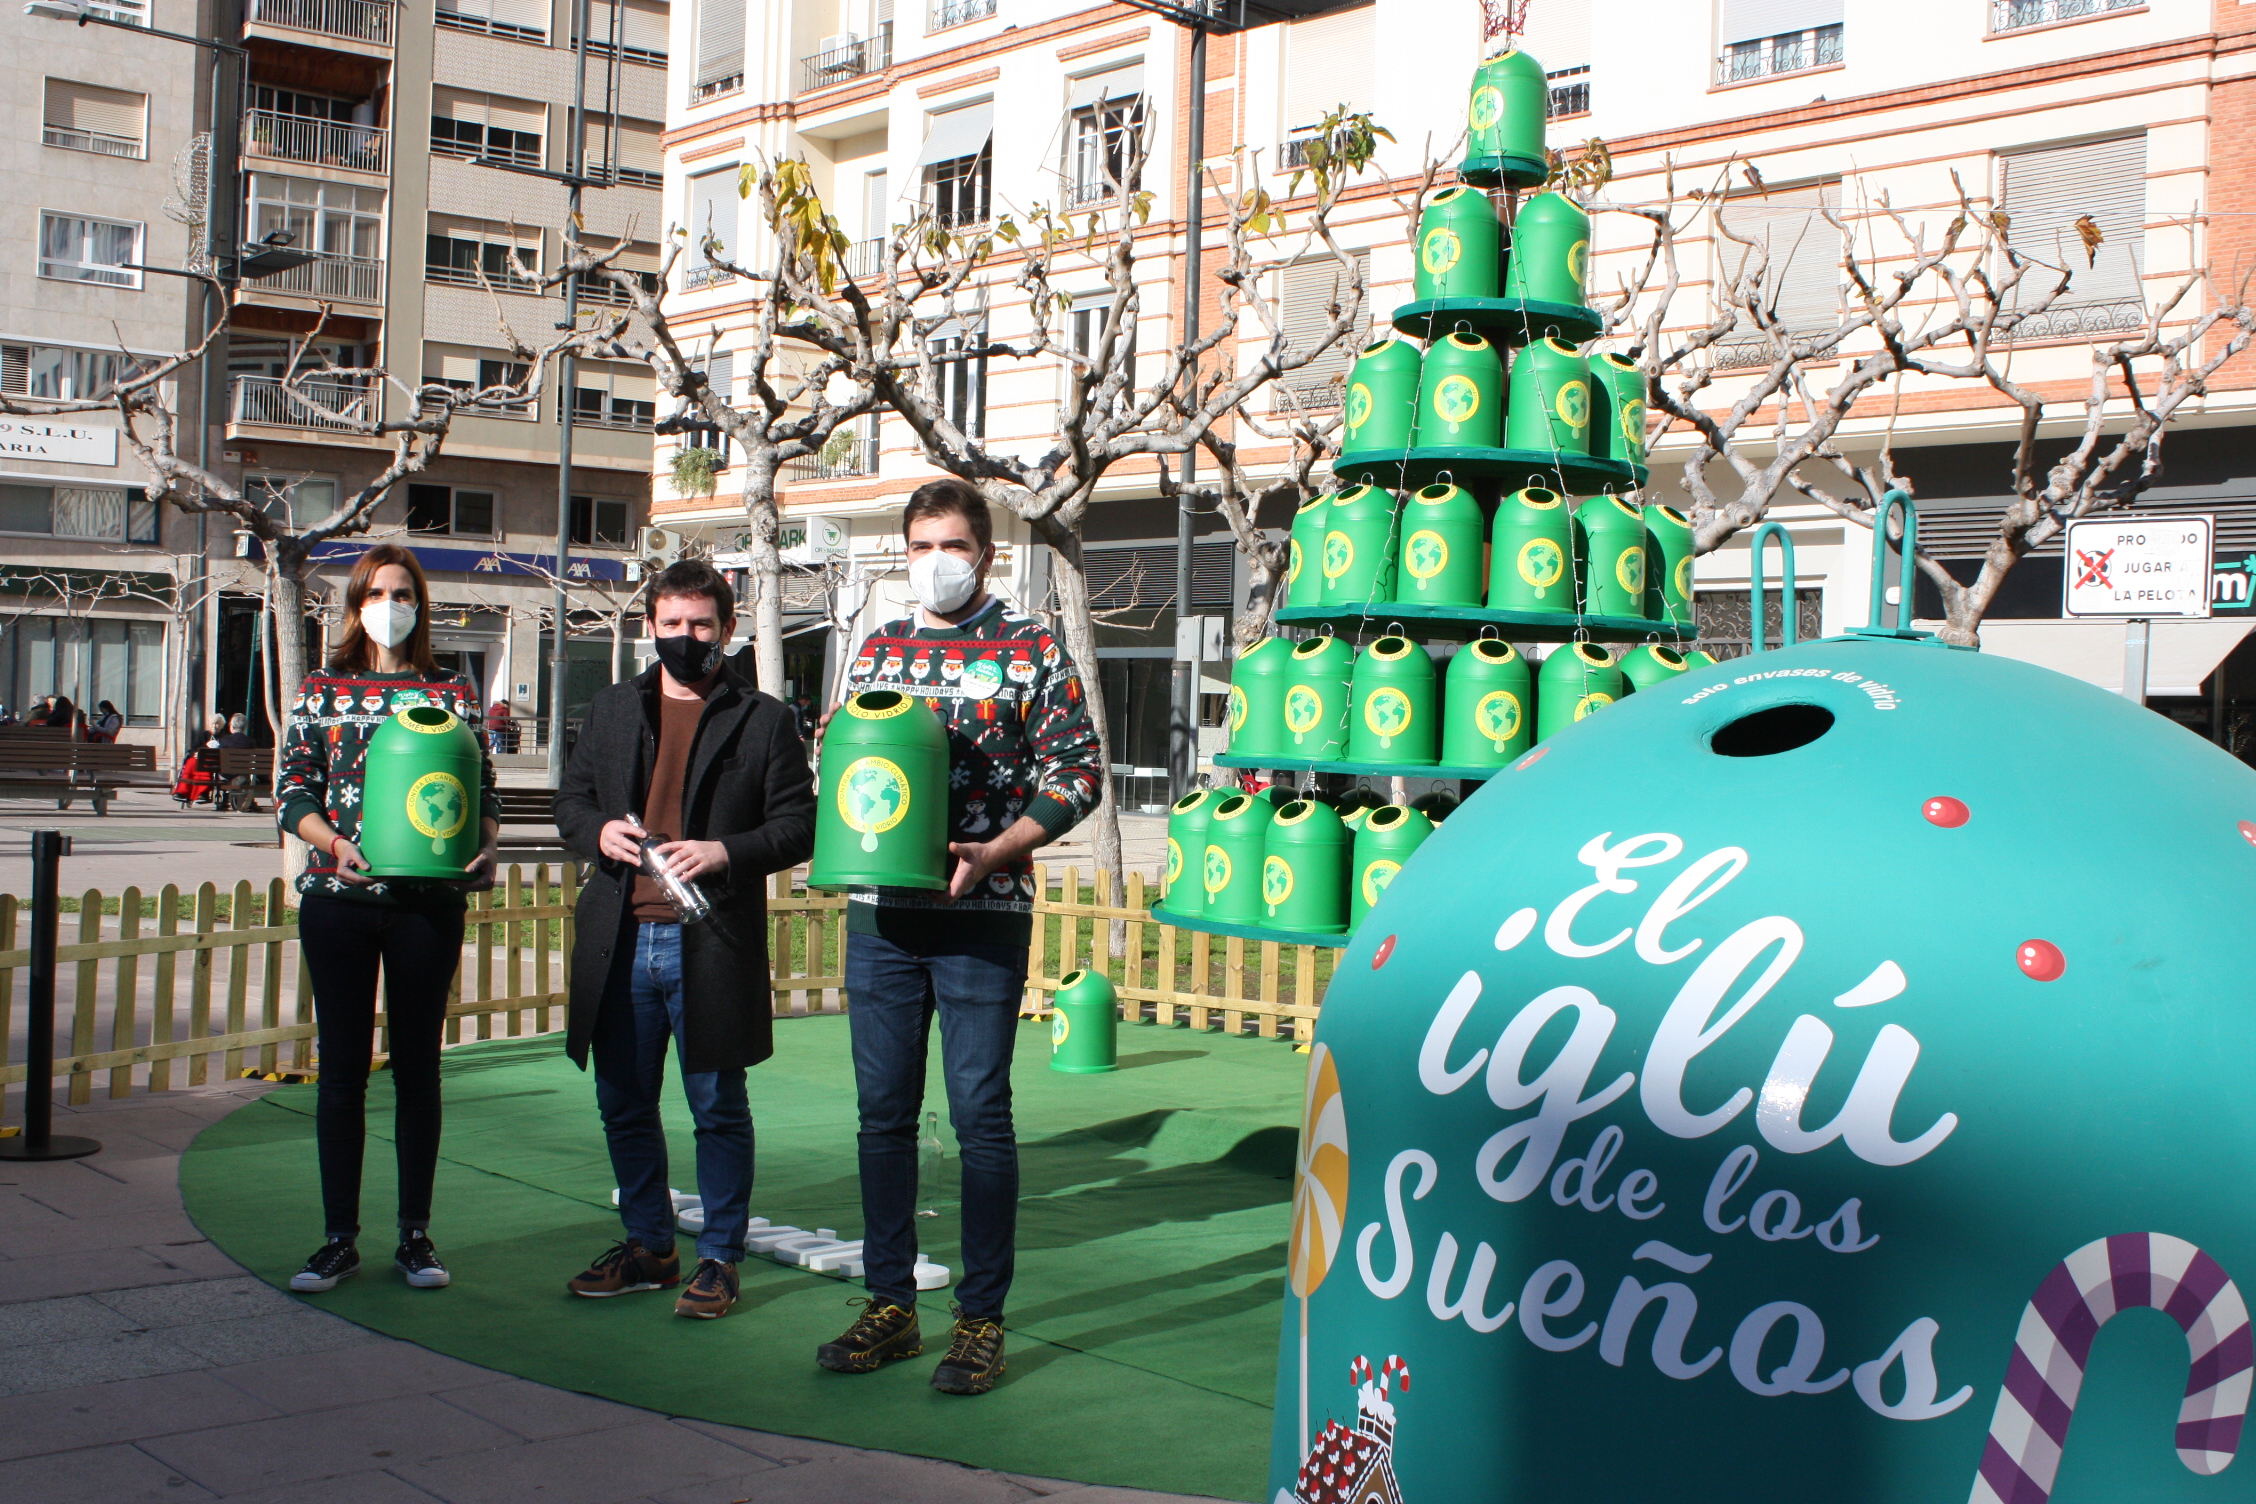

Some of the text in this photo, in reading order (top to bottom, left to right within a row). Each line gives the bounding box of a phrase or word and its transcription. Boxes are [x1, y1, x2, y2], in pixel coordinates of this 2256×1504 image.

[474, 557, 502, 572] AXA
[567, 562, 592, 578] AXA
[2124, 562, 2172, 573] JUGAR
[2114, 590, 2132, 601] LA
[920, 686, 954, 696] HOLIDAYS
[1681, 668, 1902, 710] solo envases de vidrio
[874, 703, 908, 718] VIDRIO
[430, 722, 455, 733] VIDRE
[408, 782, 425, 807] CONTRA
[434, 774, 455, 784] CANVI
[840, 774, 851, 804] CONTRA
[860, 759, 890, 769] CAMBIO
[890, 767, 908, 806] CLIMÁTICO
[413, 818, 437, 836] RECICLA
[875, 817, 898, 830] VIDRIO
[972, 900, 1011, 910] HOLIDAYS
[1545, 831, 1748, 965] El
[1418, 907, 1958, 1203] iglú
[1550, 1125, 1881, 1255] de los
[1355, 1149, 1974, 1421] Sueños
